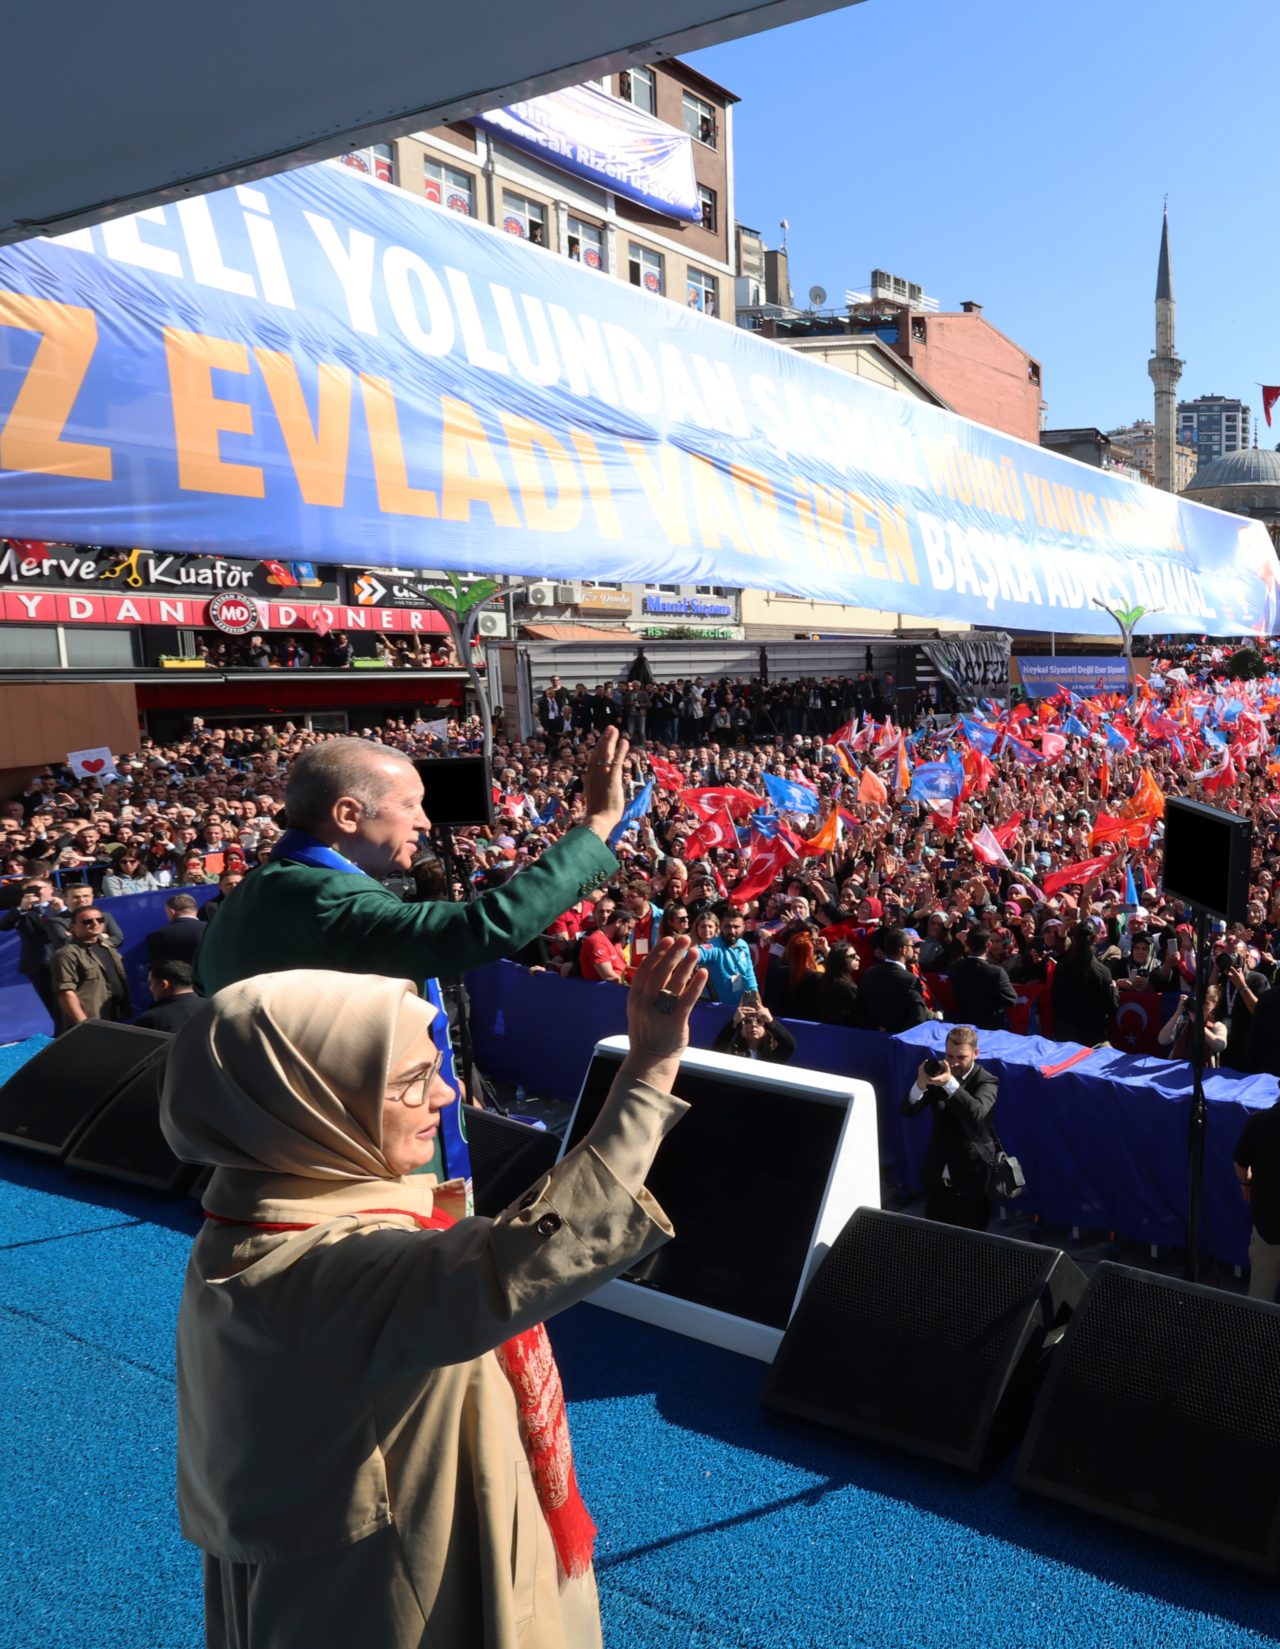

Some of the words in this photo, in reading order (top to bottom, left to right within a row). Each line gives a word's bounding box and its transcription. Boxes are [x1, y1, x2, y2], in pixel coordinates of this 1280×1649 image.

[302, 209, 750, 438] YOLUNDAN
[162, 325, 624, 540] EVLADI
[620, 437, 794, 560] VAR
[16, 594, 185, 623] YDAN
[147, 556, 254, 588] Kuaför
[917, 511, 1043, 611] BAŞKA
[1036, 544, 1132, 612] ADRES
